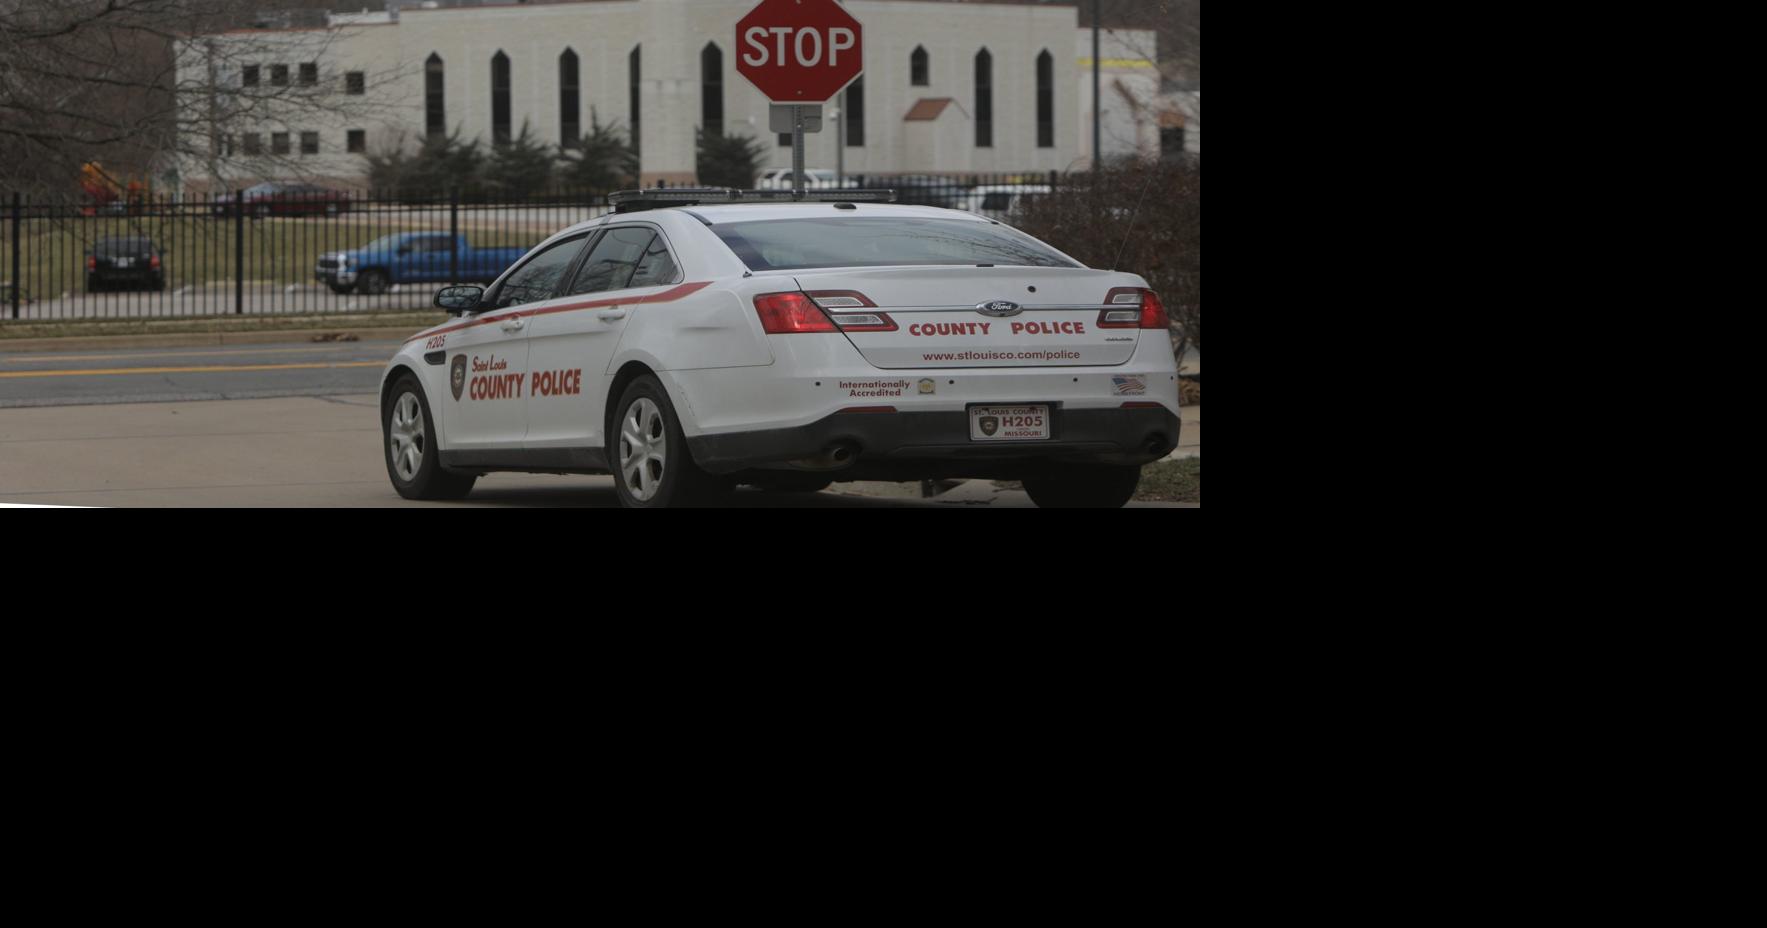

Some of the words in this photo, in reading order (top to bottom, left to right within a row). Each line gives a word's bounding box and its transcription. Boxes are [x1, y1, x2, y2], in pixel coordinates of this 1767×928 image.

[743, 26, 855, 67] STOP
[909, 322, 991, 336] COUNTY
[1011, 321, 1085, 335] POLICE
[426, 335, 446, 349] H205
[923, 349, 1081, 361] www.stlouisco.com/police
[472, 356, 489, 372] Saint
[490, 354, 507, 370] Louis
[470, 373, 525, 400] COUNTY
[531, 368, 581, 396] POLICE
[839, 380, 910, 389] Internationally
[849, 389, 901, 397] Accredited
[1002, 416, 1043, 427] H205
